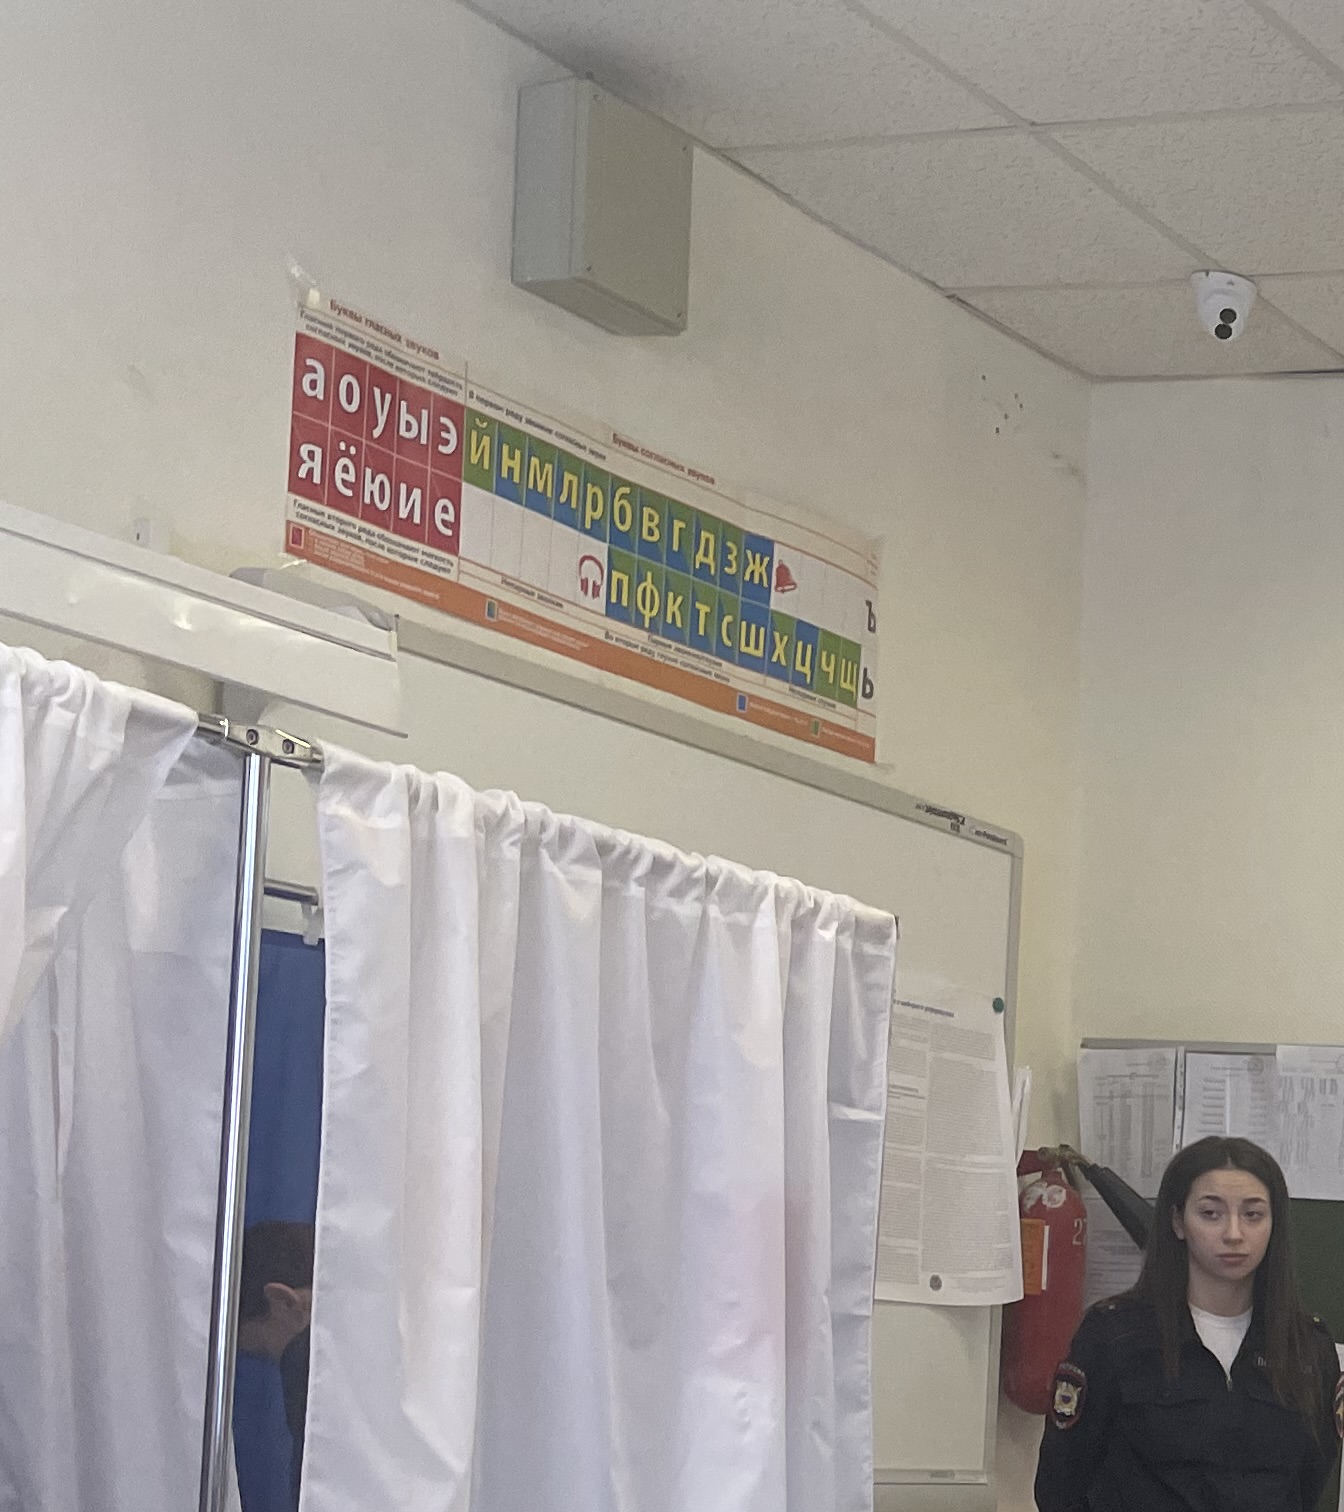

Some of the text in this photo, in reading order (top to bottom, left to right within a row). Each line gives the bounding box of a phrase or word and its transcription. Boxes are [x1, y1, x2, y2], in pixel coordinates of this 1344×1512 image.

[301, 357, 326, 401] а
[338, 373, 361, 413] о
[372, 386, 392, 439] у
[399, 400, 429, 446] ы
[438, 415, 458, 456] э
[297, 441, 456, 537] я ё ю и е
[470, 417, 490, 469] й
[501, 443, 522, 484] н
[528, 455, 553, 498] м
[559, 471, 579, 509] л
[585, 482, 604, 529] р
[613, 486, 632, 532] б
[642, 506, 660, 543] в
[673, 518, 687, 552] г
[695, 529, 716, 575] д
[723, 539, 739, 576] з
[743, 548, 770, 587] ж
[610, 569, 630, 606] п
[635, 572, 660, 627] ф
[666, 592, 684, 630] к
[694, 601, 711, 637] т
[720, 614, 734, 648] с
[739, 621, 766, 658] ш
[771, 631, 789, 667] х
[795, 640, 813, 685] ц
[820, 650, 835, 684] ч
[839, 658, 858, 695] щ
